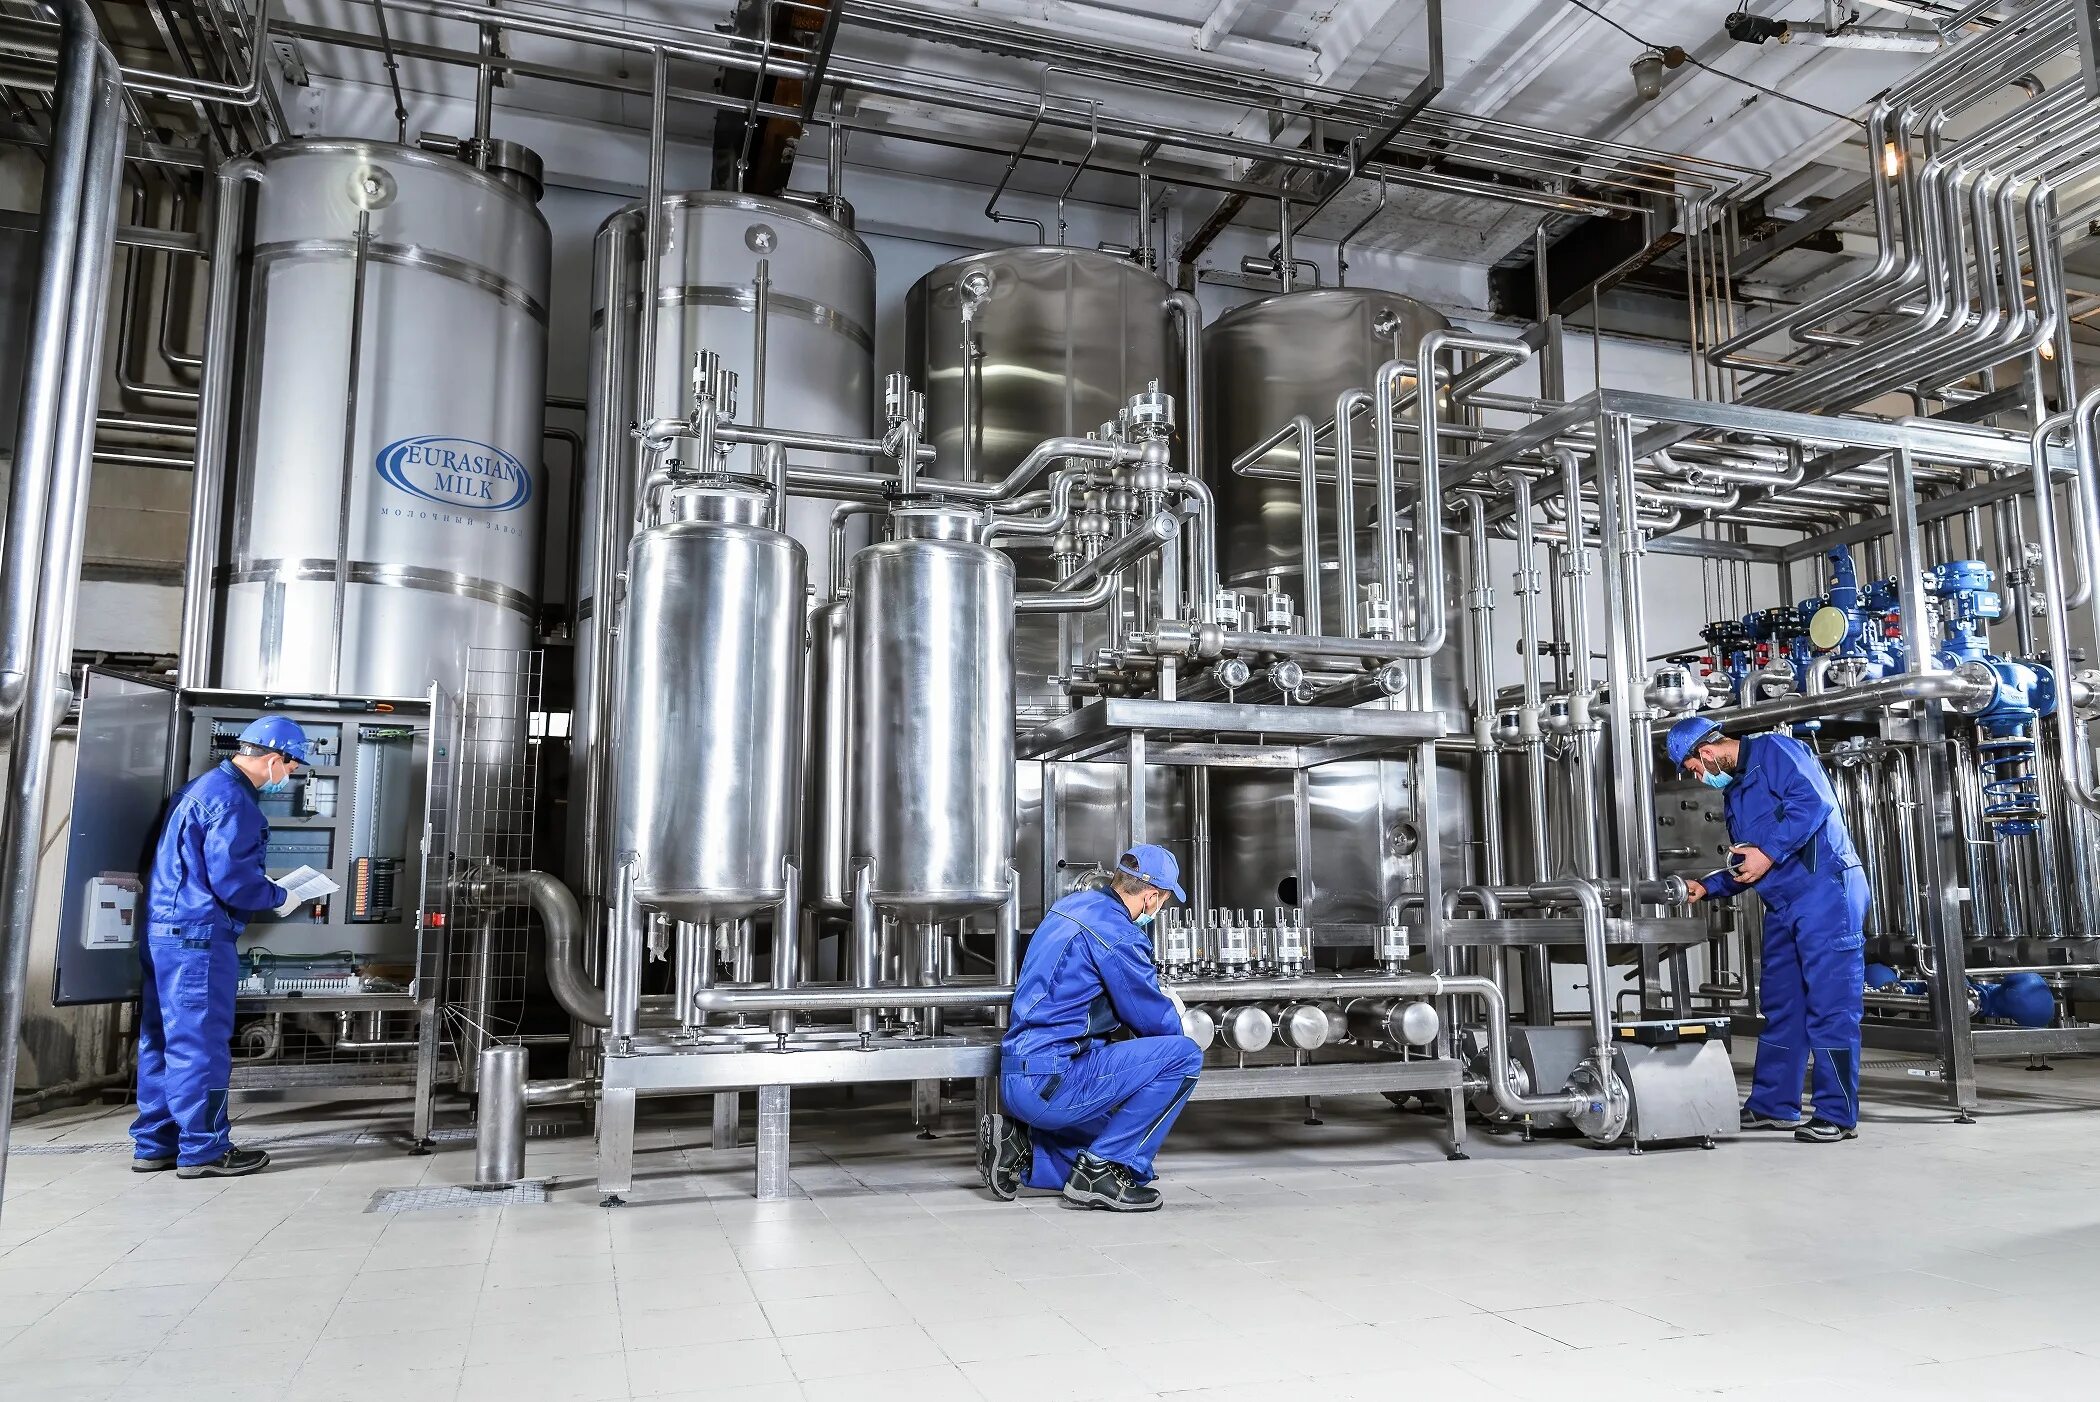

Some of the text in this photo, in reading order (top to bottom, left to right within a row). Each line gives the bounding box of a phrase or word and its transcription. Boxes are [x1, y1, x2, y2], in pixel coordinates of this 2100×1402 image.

[406, 445, 517, 482] EURASIAN
[434, 472, 494, 500] MILK
[381, 508, 473, 526] МОЛОЧНЫЙ
